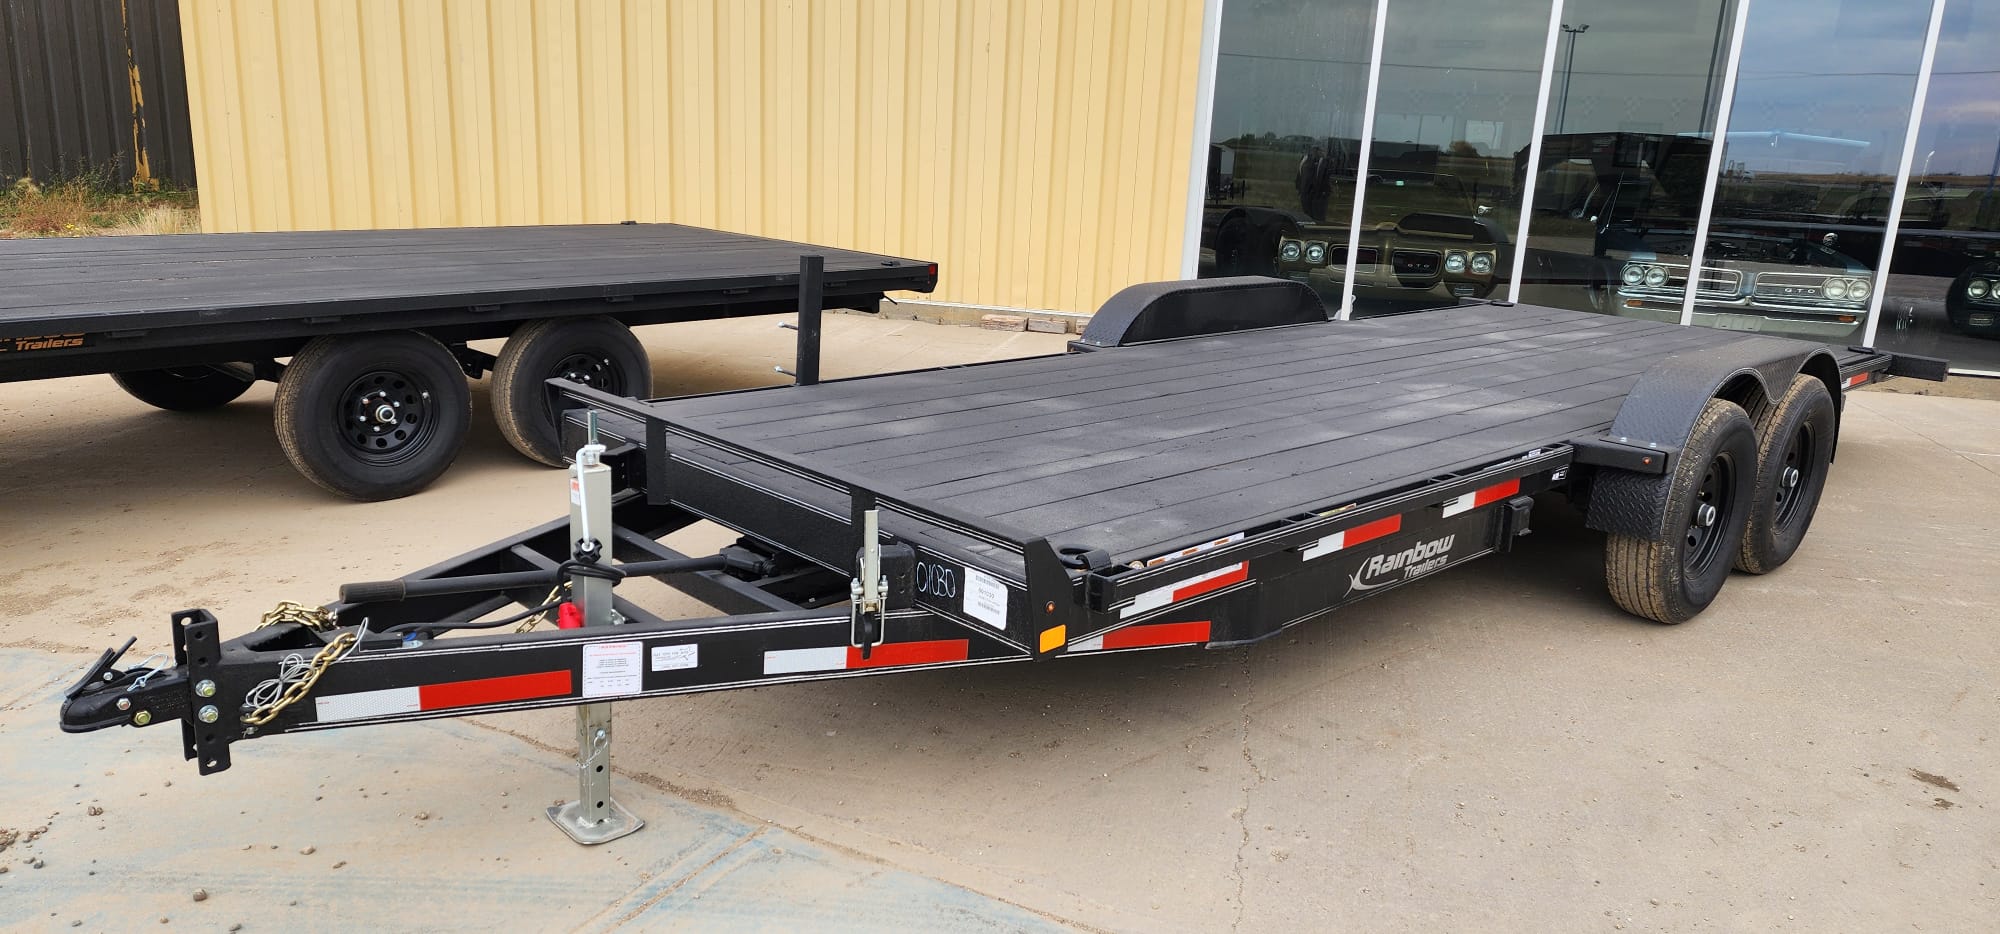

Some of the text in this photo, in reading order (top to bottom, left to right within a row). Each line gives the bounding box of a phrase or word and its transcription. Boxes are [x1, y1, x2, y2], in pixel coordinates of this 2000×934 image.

[15, 338, 84, 351] Trailers
[1365, 534, 1456, 580] Rainbow
[1403, 554, 1449, 580] Trailers
[916, 561, 956, 598] 01030
